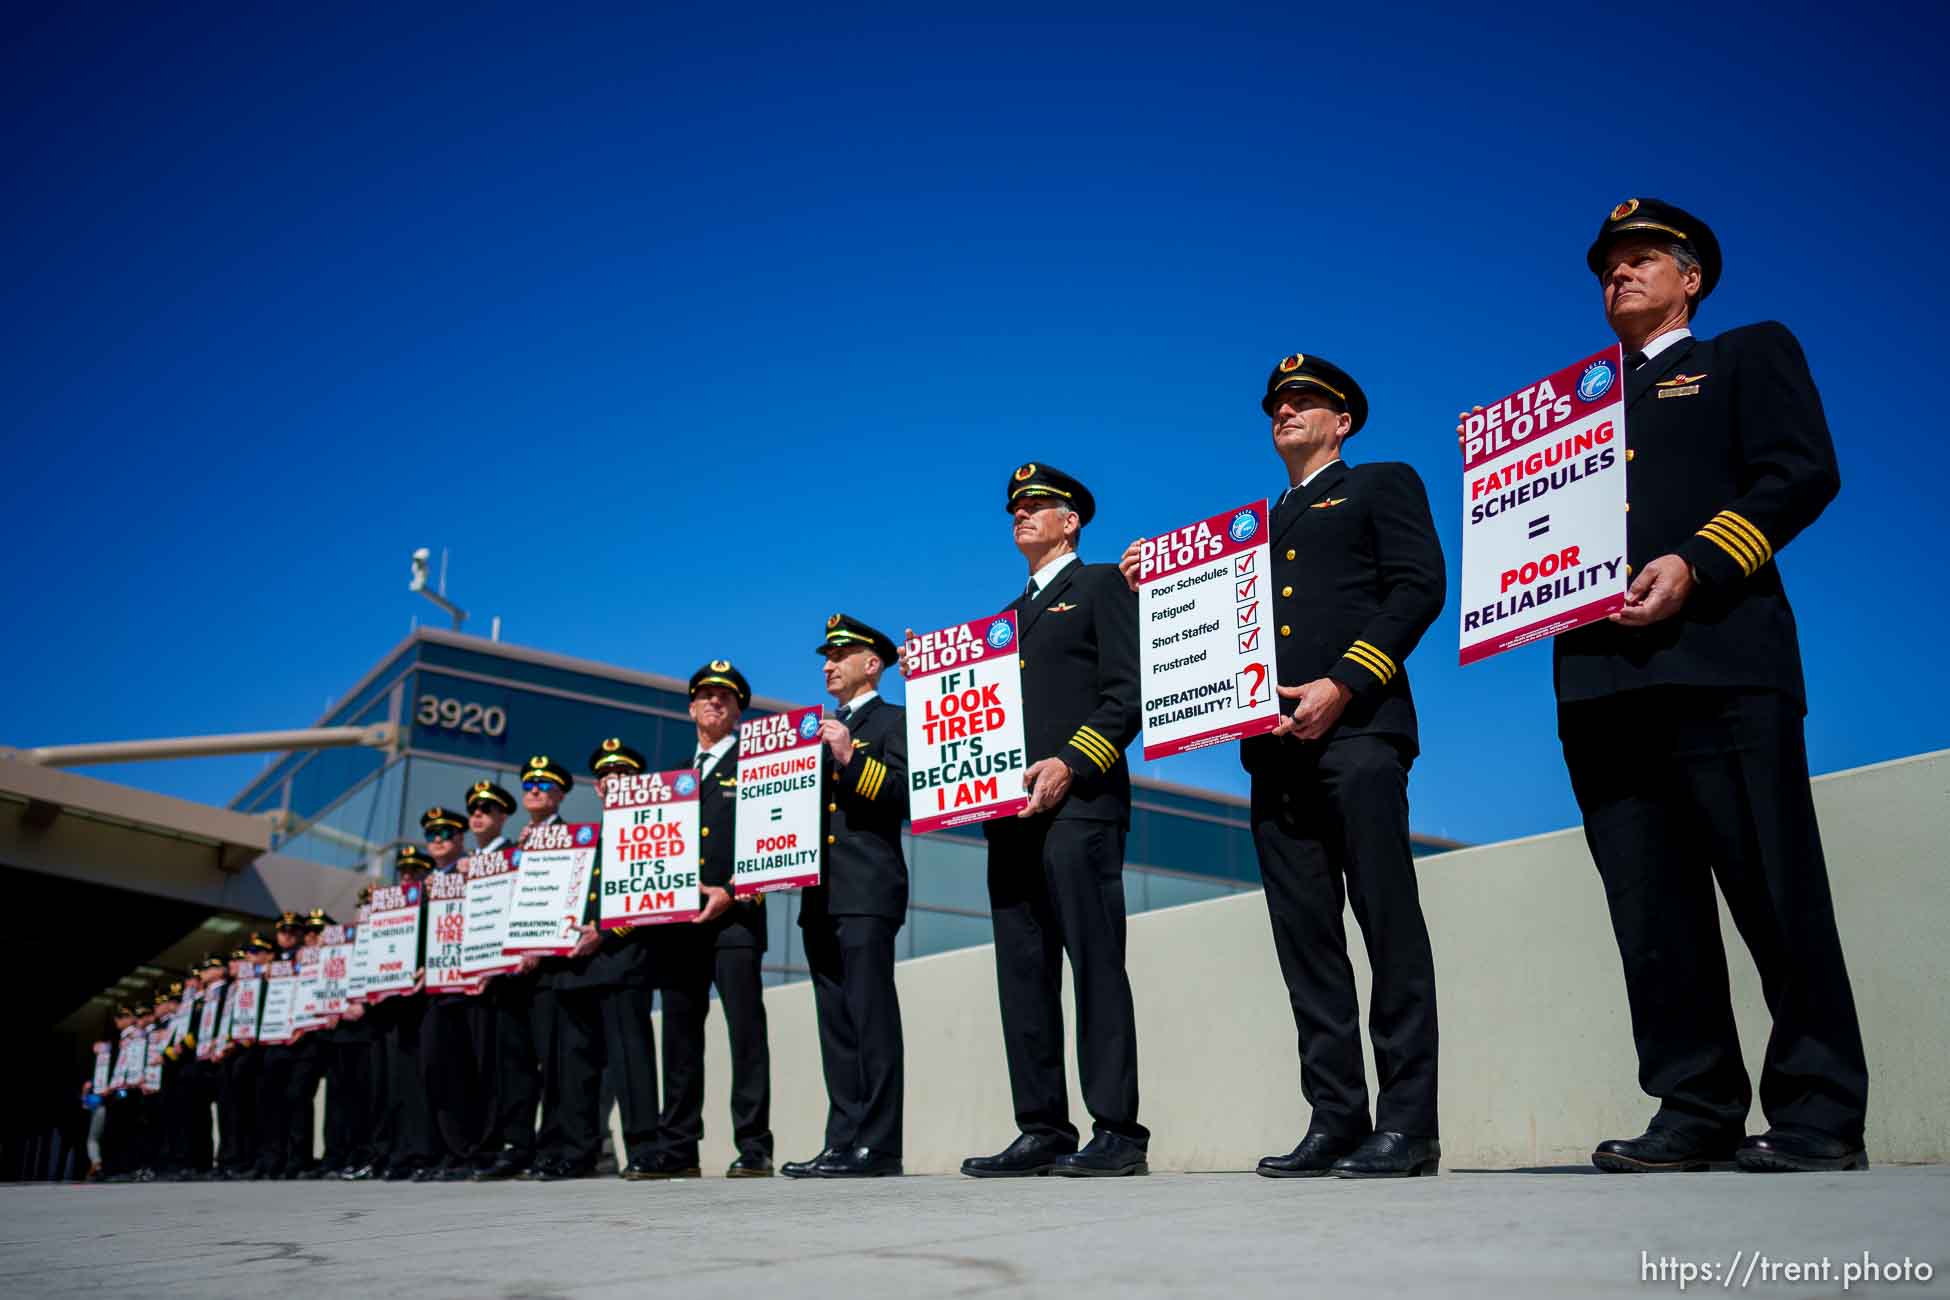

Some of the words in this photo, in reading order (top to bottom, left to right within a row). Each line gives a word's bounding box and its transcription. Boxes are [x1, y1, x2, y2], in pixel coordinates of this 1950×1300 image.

[1465, 379, 1556, 442] DELTA
[1465, 394, 1572, 465] PILOTS
[1471, 420, 1614, 501] FATIGUING
[1471, 447, 1615, 525] SCHEDULES
[1139, 521, 1212, 561] DELTA
[1139, 535, 1224, 579] PILOTS
[1500, 545, 1581, 594] POOR
[1151, 583, 1174, 599] Poor
[1177, 565, 1228, 589] Schedules
[1464, 556, 1623, 632] RELIABILITY
[1151, 600, 1196, 622] Fatigued
[905, 624, 973, 657] DELTA
[1152, 633, 1180, 649] Short
[1182, 620, 1220, 641] Staffed
[907, 638, 984, 672] PILOTS
[1152, 650, 1207, 674] Frustrated
[941, 673, 961, 694] IF
[969, 669, 975, 688] I
[1145, 679, 1234, 712] OPERATIONAL
[417, 695, 507, 736] 3920
[925, 683, 1001, 722] LOOK
[1149, 697, 1232, 728] RELIABILITY?
[740, 713, 790, 741] DELTA
[922, 707, 1006, 745] TIRED
[739, 728, 797, 757] PILOTS
[940, 736, 983, 764] IT'S
[607, 773, 664, 794] DELTA
[742, 755, 816, 784] FATIGUING
[911, 749, 1022, 792] BECAUSE
[605, 785, 672, 808] PILOTS
[741, 774, 816, 801] SCHEDULES
[938, 788, 944, 811] I
[954, 776, 998, 808] AM
[634, 809, 651, 824] IF
[657, 808, 663, 822] I
[619, 821, 682, 844] LOOK
[756, 833, 797, 854] POOR
[616, 839, 686, 862] TIRED
[737, 849, 818, 874] RELIABILITY
[604, 872, 697, 896] BECAUSE
[625, 895, 631, 912] I
[638, 891, 675, 911] AM
[436, 928, 464, 943] TIRE
[437, 914, 464, 929] LOO
